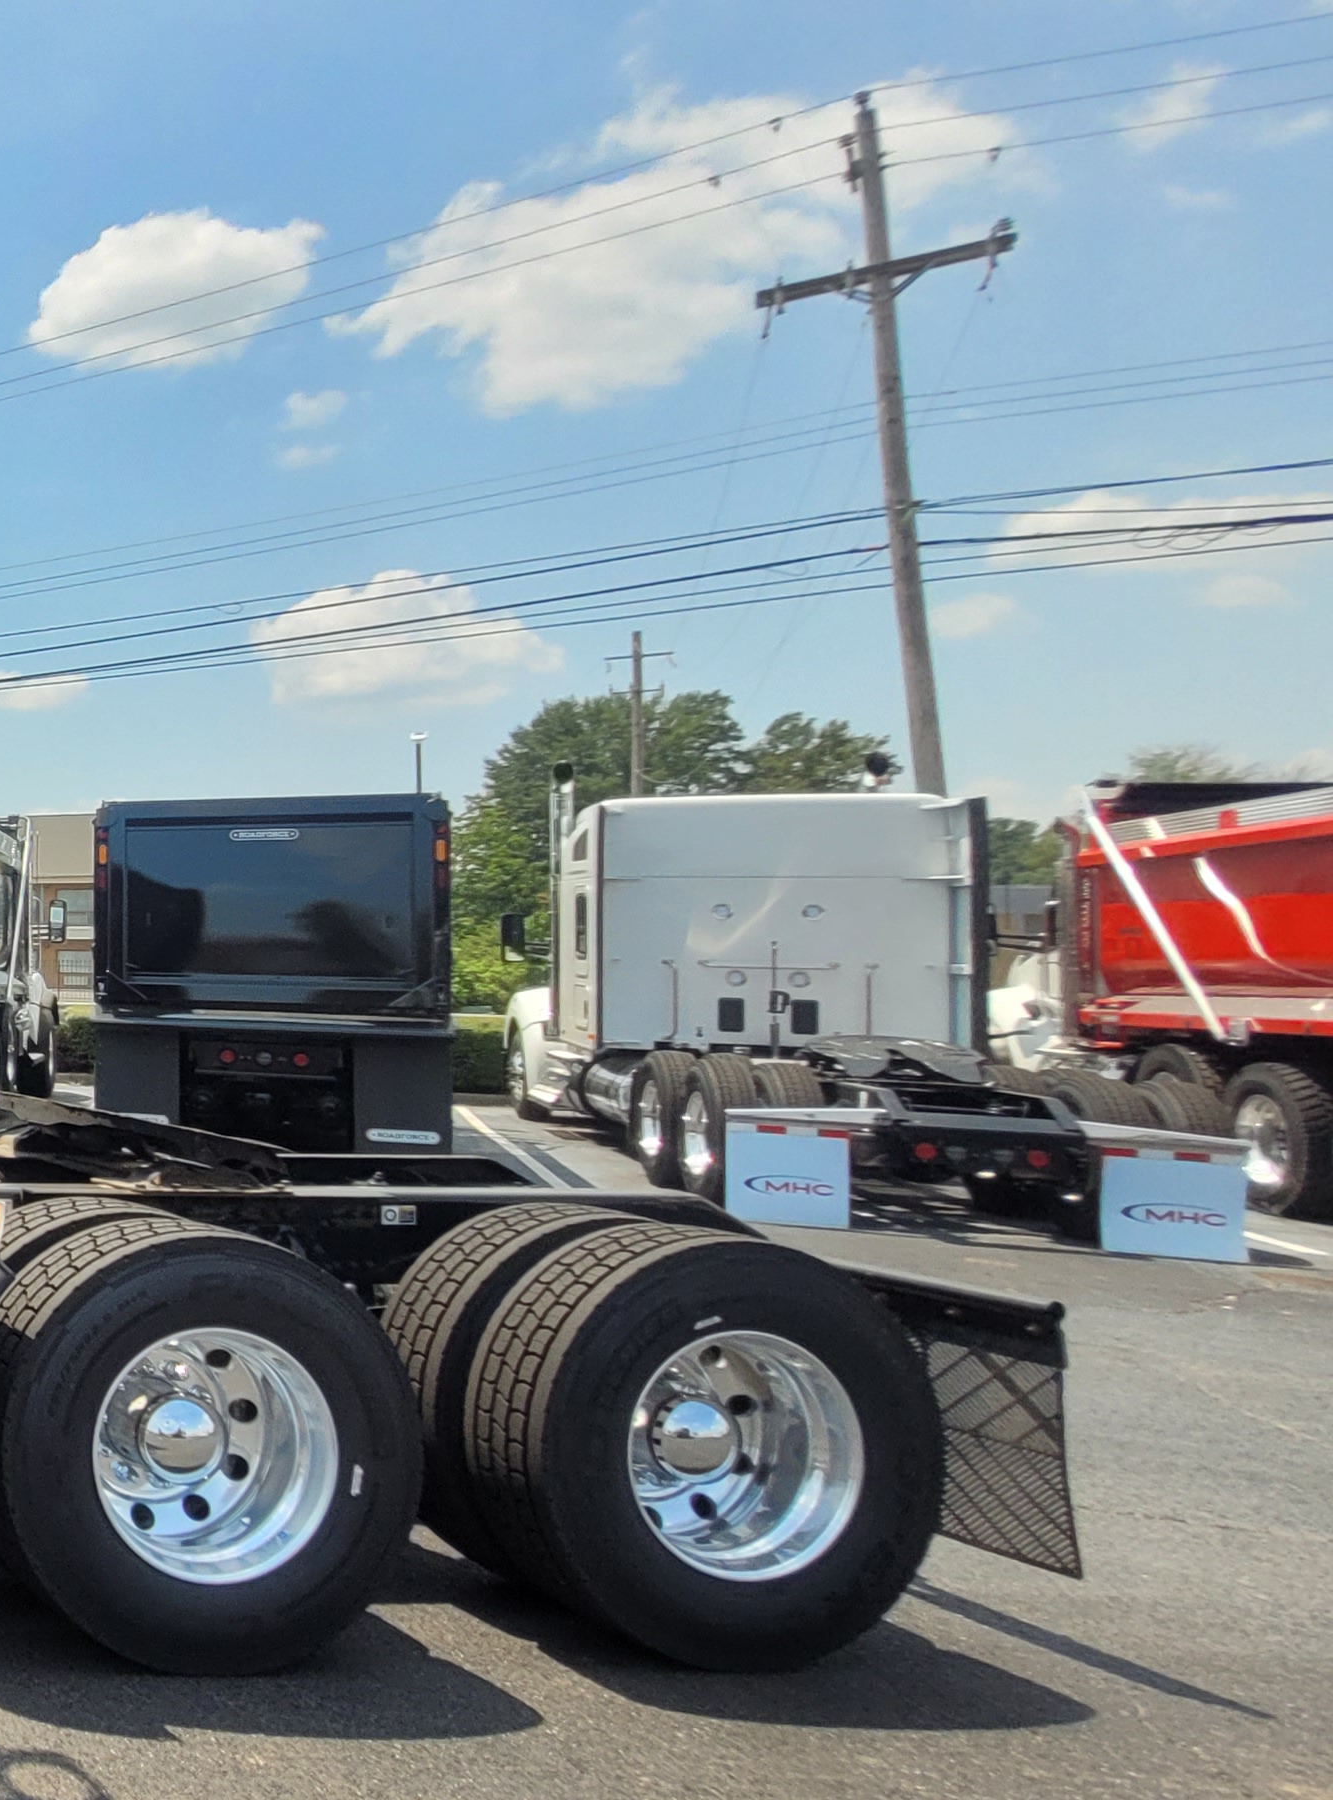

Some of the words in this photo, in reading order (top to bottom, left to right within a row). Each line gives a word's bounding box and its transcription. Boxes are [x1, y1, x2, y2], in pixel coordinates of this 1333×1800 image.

[376, 1131, 430, 1141] ROADFORCE
[764, 1180, 835, 1197] MHC
[1144, 1208, 1228, 1227] MHC
